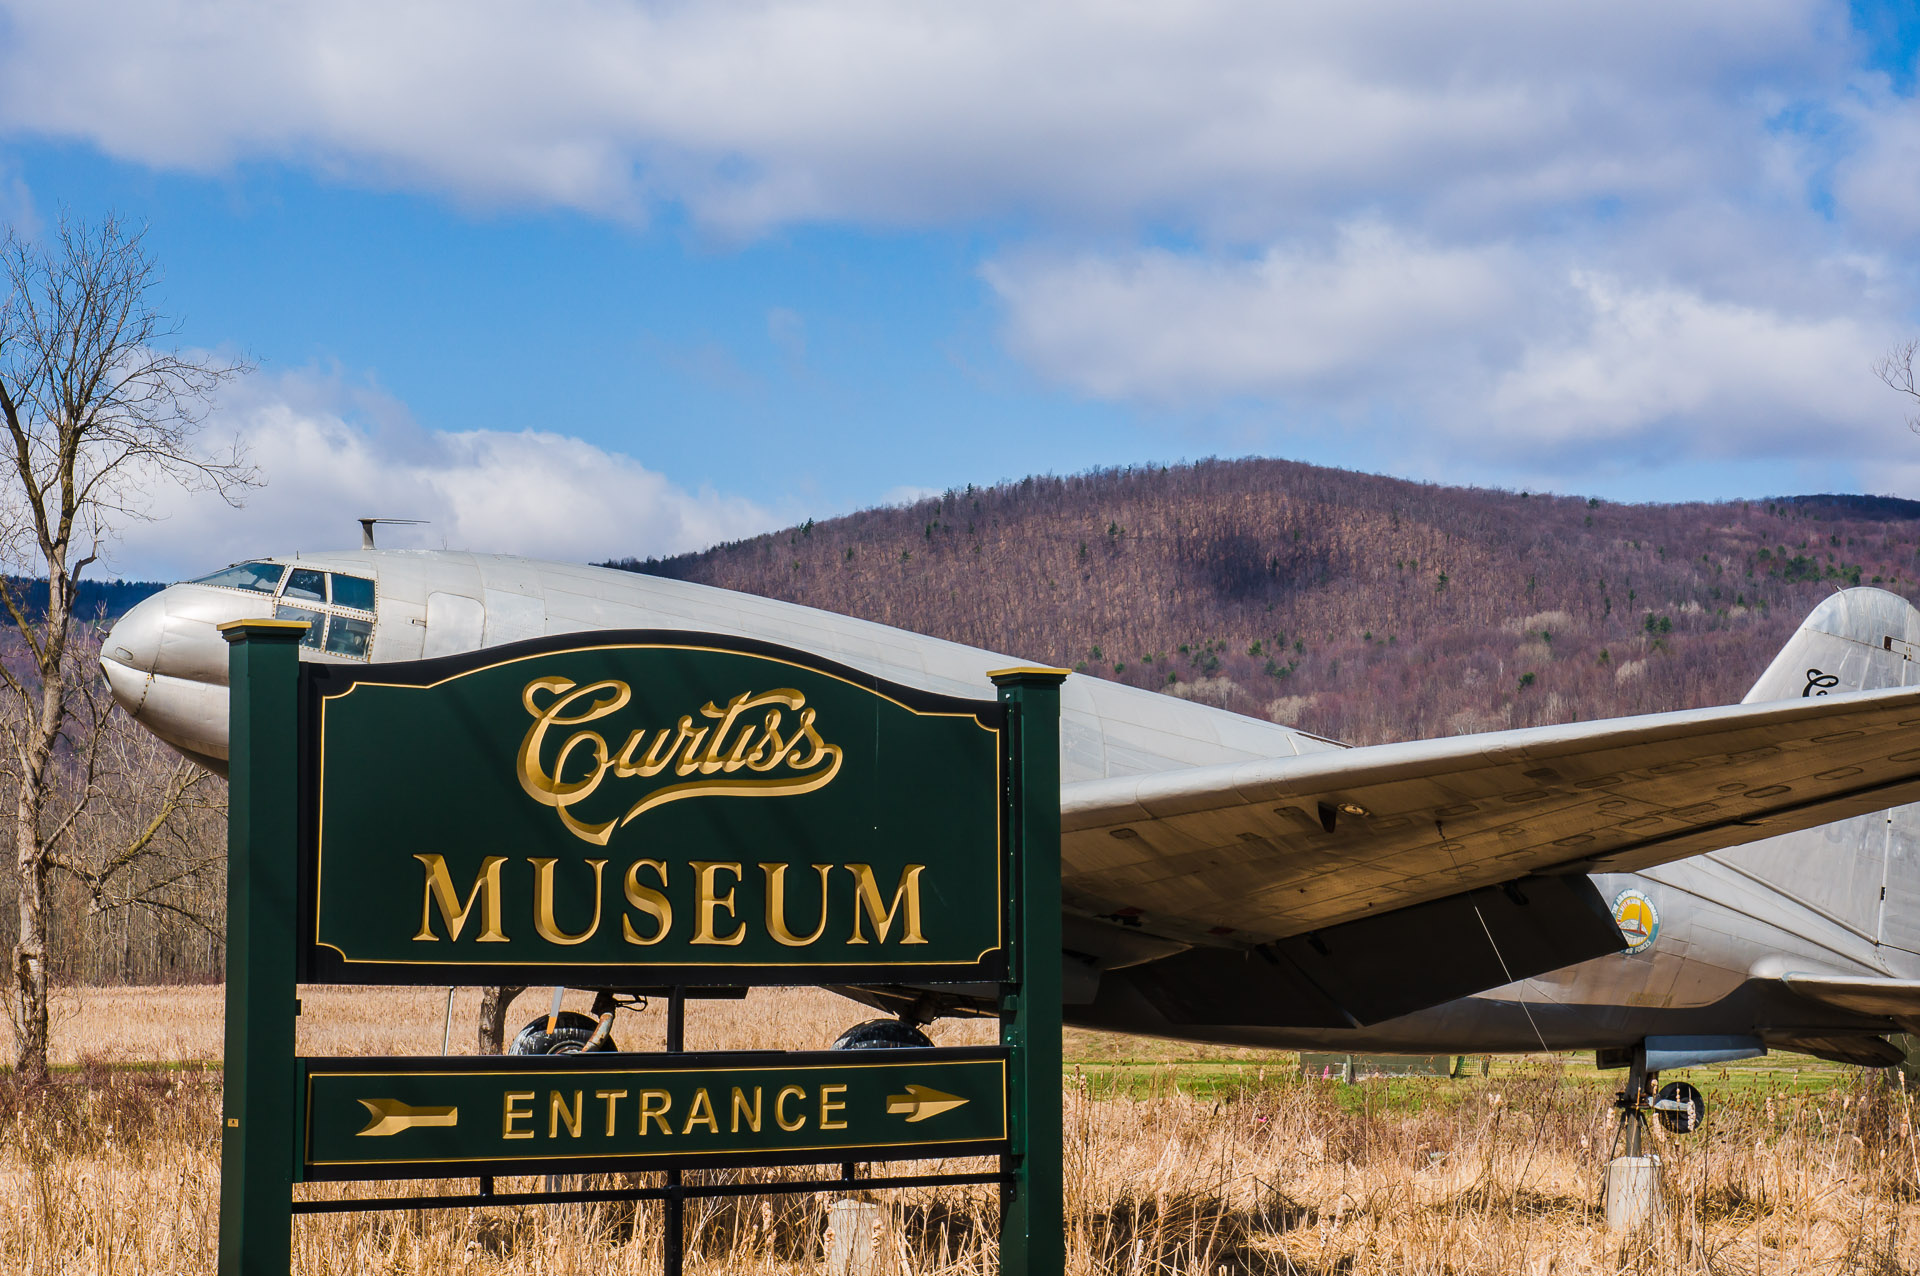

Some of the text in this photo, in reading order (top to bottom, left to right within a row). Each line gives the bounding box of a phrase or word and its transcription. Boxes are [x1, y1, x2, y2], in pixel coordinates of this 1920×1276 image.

[517, 676, 843, 846] Curtiss
[412, 854, 928, 946] MUSEUM
[502, 1084, 847, 1139] ENTRANCE
